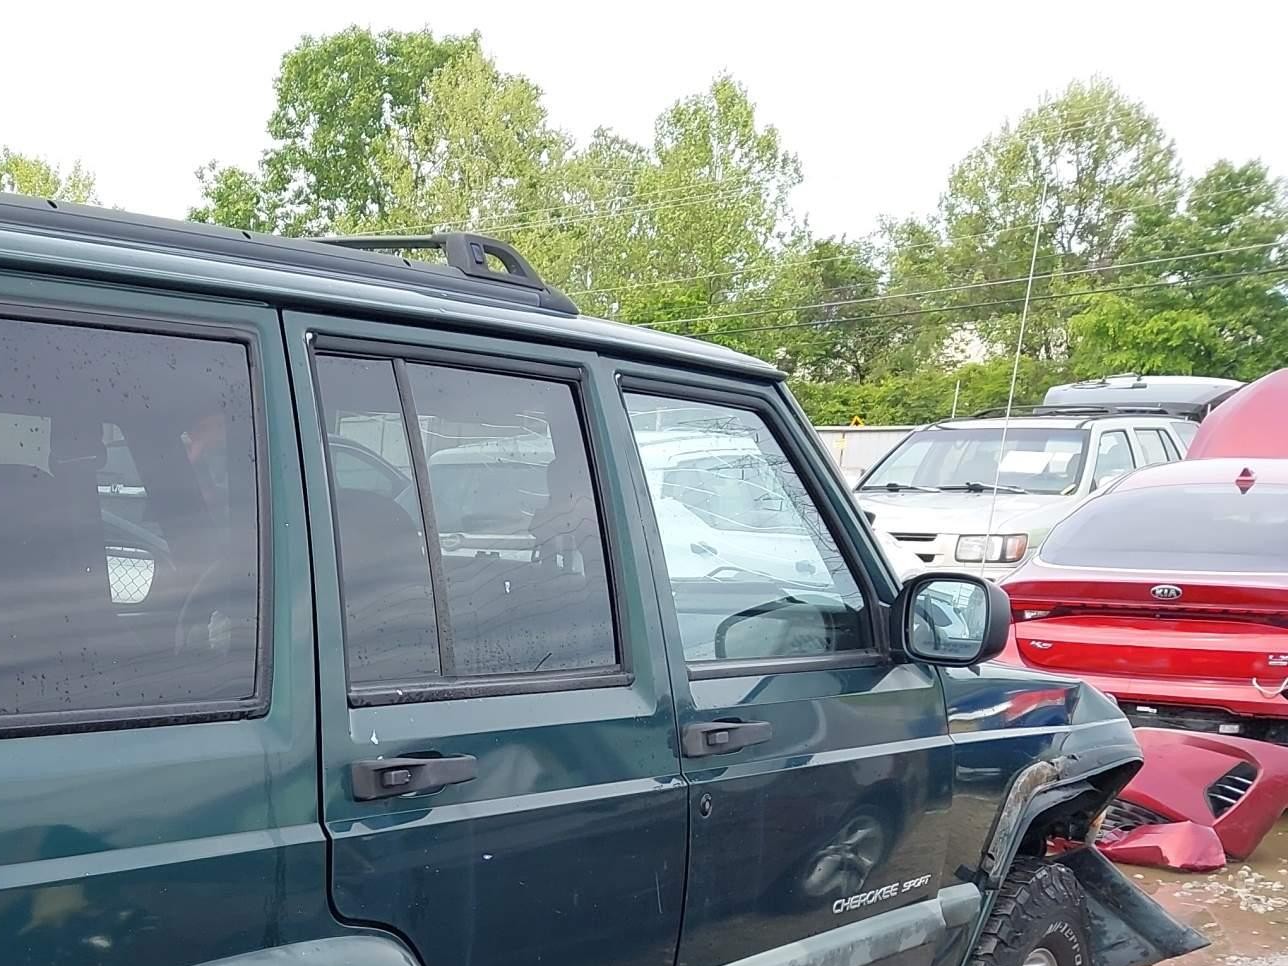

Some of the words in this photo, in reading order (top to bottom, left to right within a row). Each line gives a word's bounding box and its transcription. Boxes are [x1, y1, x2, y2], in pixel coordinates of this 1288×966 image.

[1155, 587, 1177, 598] KIA
[832, 882, 900, 914] CHEROKEE
[901, 874, 932, 893] SPORT
